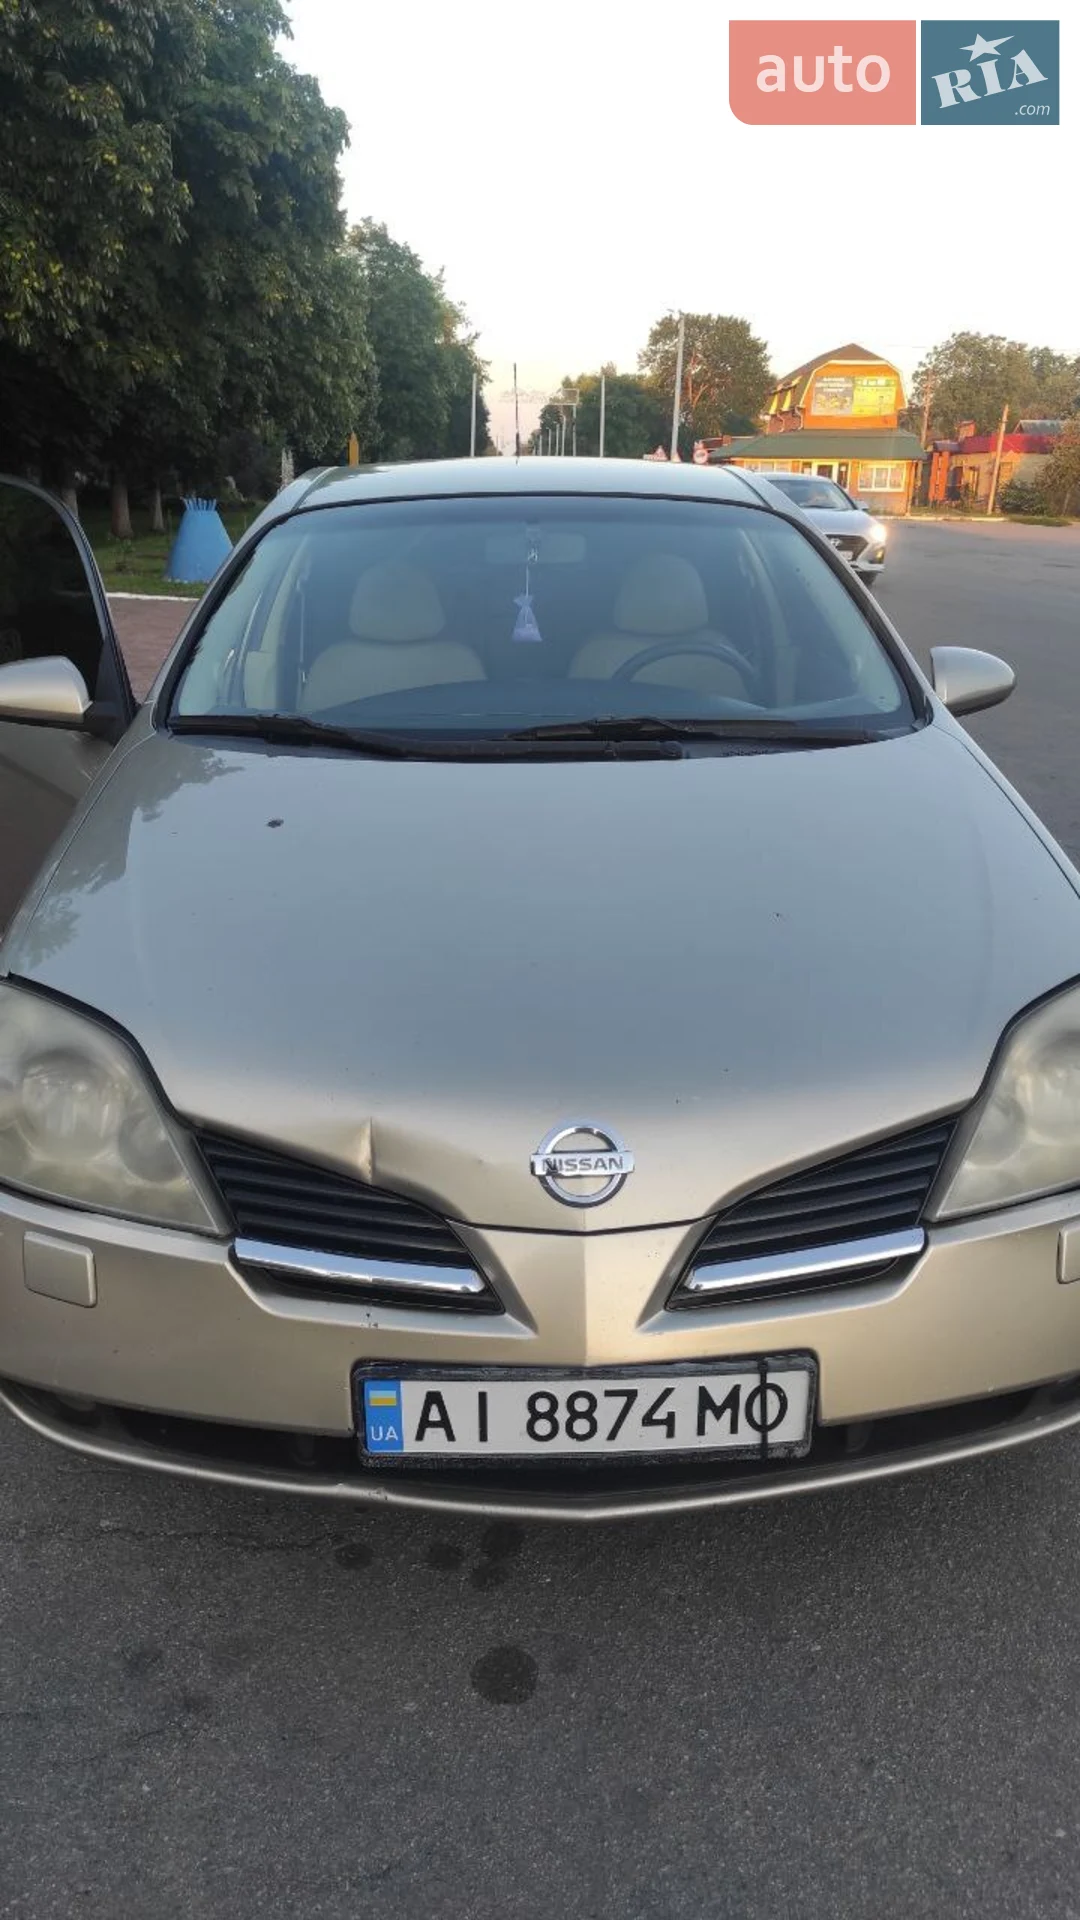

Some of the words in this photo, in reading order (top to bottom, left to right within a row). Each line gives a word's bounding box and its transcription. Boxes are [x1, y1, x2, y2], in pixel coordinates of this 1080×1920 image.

[542, 1157, 624, 1172] NISSAN
[415, 1391, 488, 1442] AI
[526, 1386, 676, 1442] 8874
[371, 1426, 399, 1441] UA
